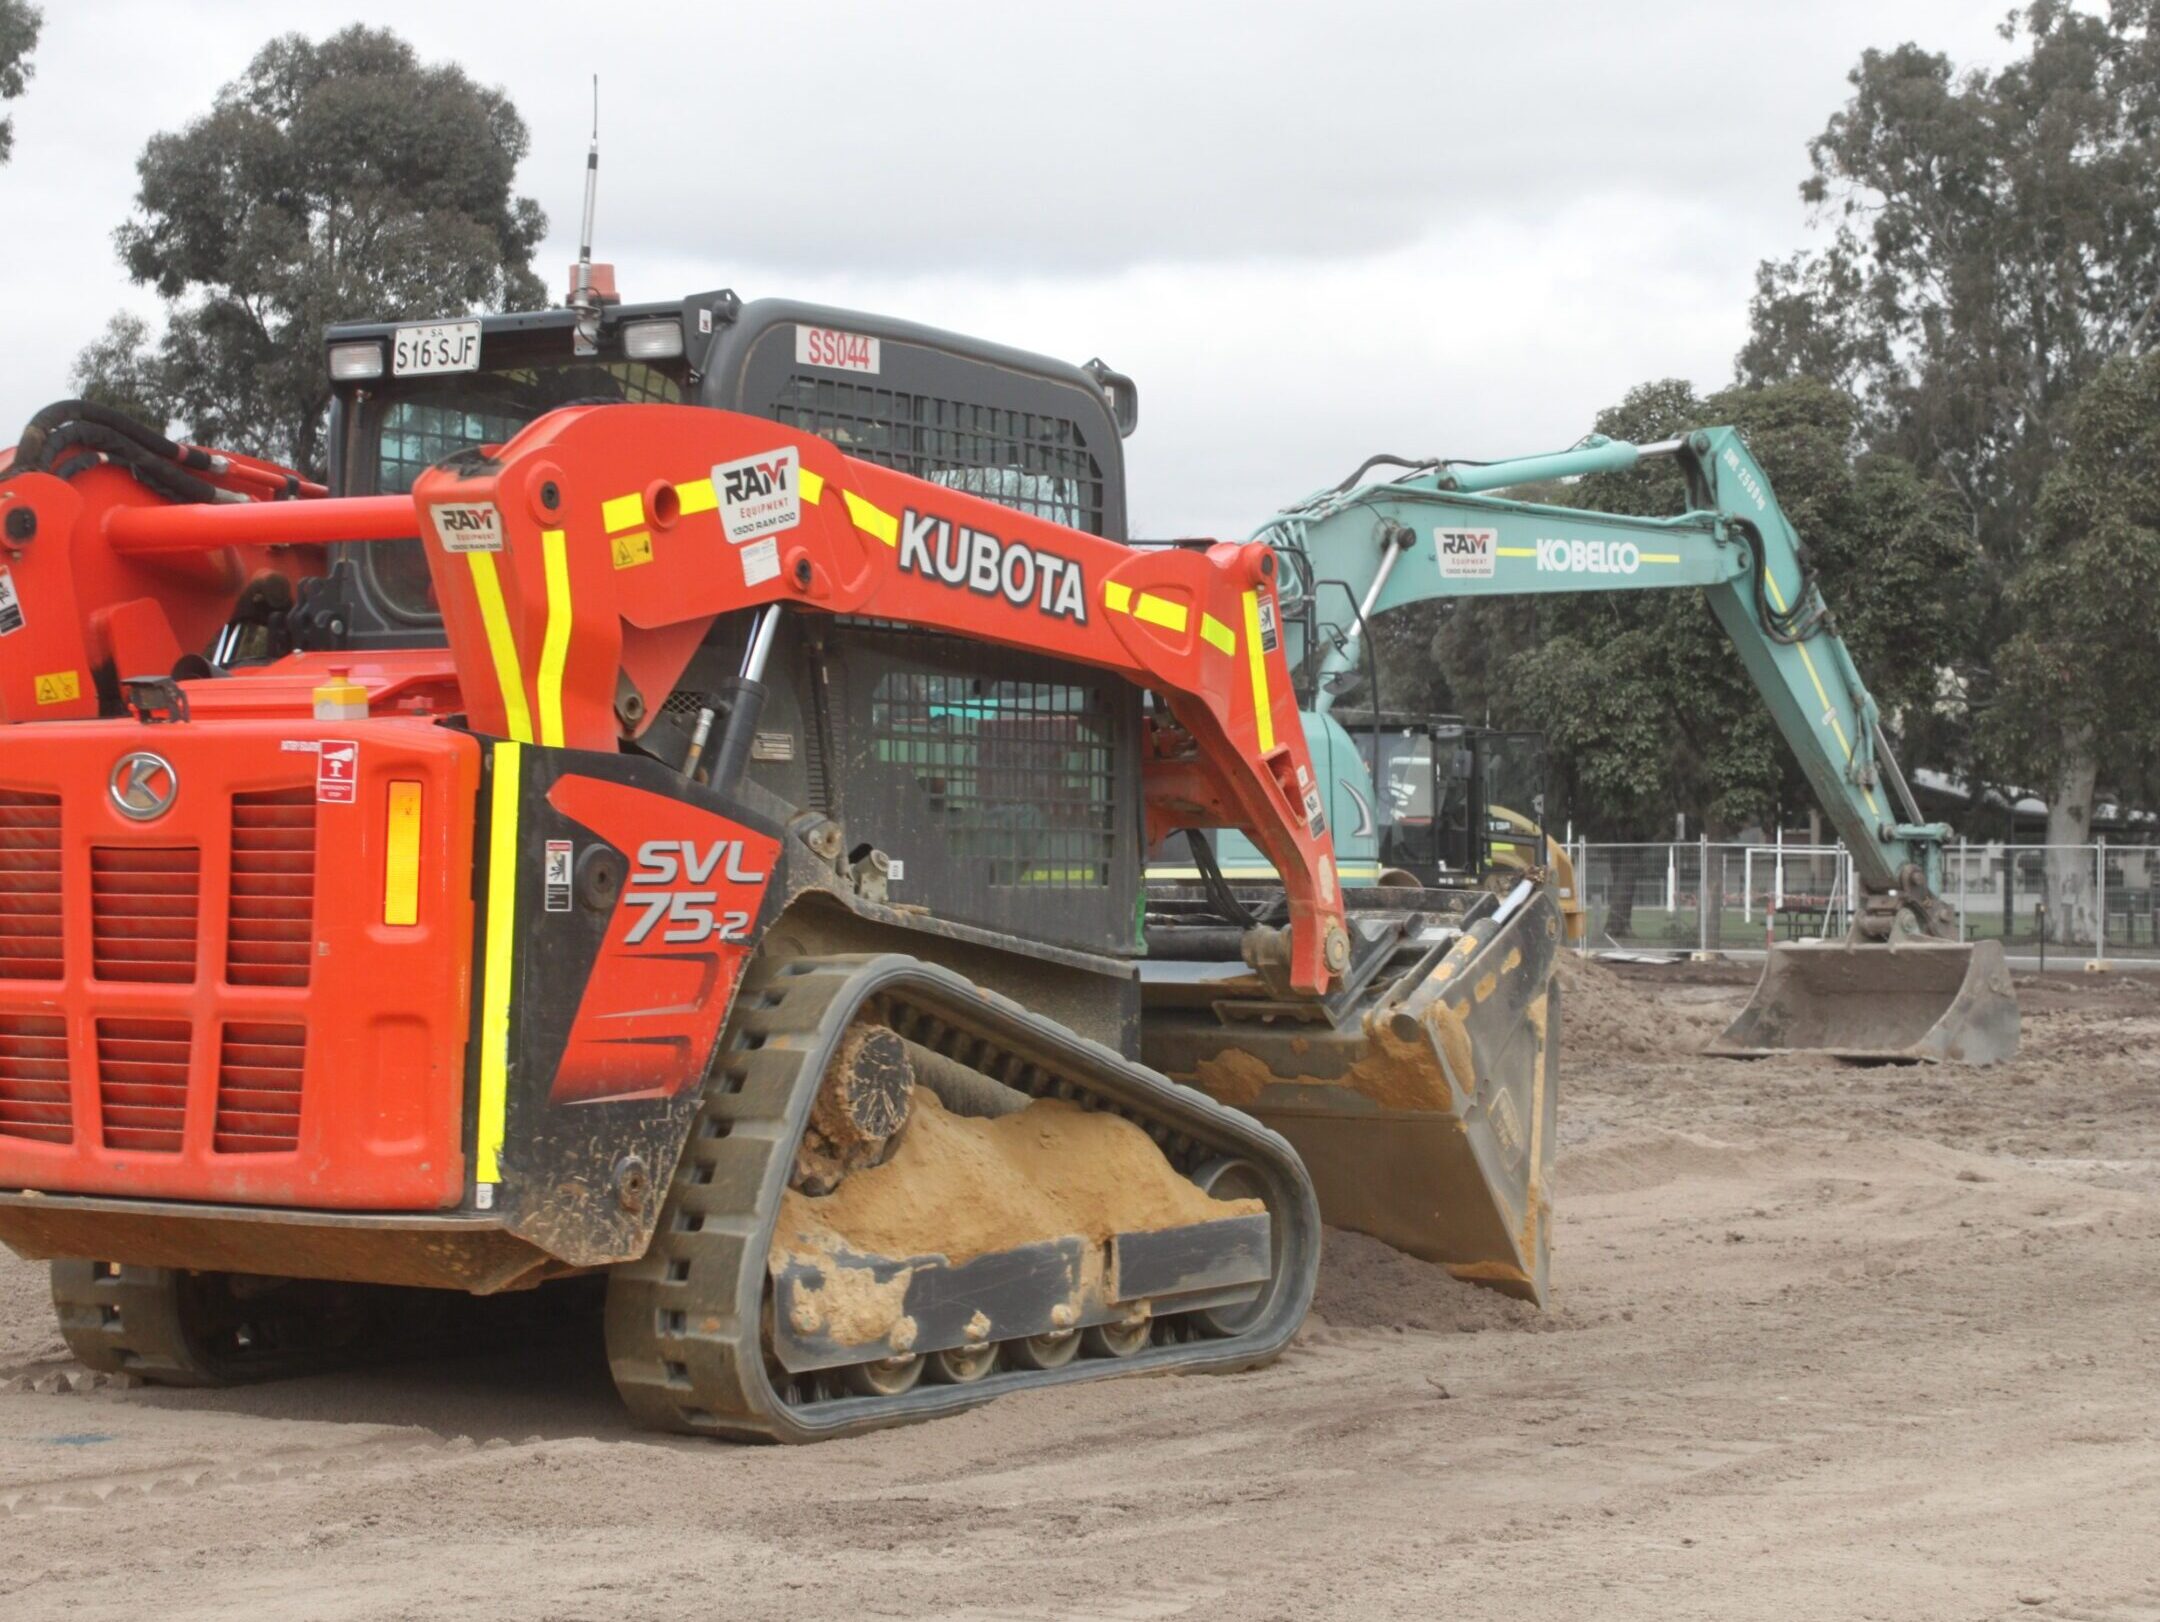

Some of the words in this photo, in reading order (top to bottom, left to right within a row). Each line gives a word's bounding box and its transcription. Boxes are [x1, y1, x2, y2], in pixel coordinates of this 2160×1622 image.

[809, 330, 869, 369] SS044
[722, 457, 788, 505] RAM
[441, 508, 493, 531] RAM
[740, 498, 788, 518] EQUIPMENT
[756, 517, 777, 529] RAM
[778, 511, 796, 524] 000
[1443, 533, 1490, 554] RAM
[1536, 538, 1640, 574] KOBELCO
[900, 508, 1087, 622] KUBOTA
[631, 841, 764, 884] SVL
